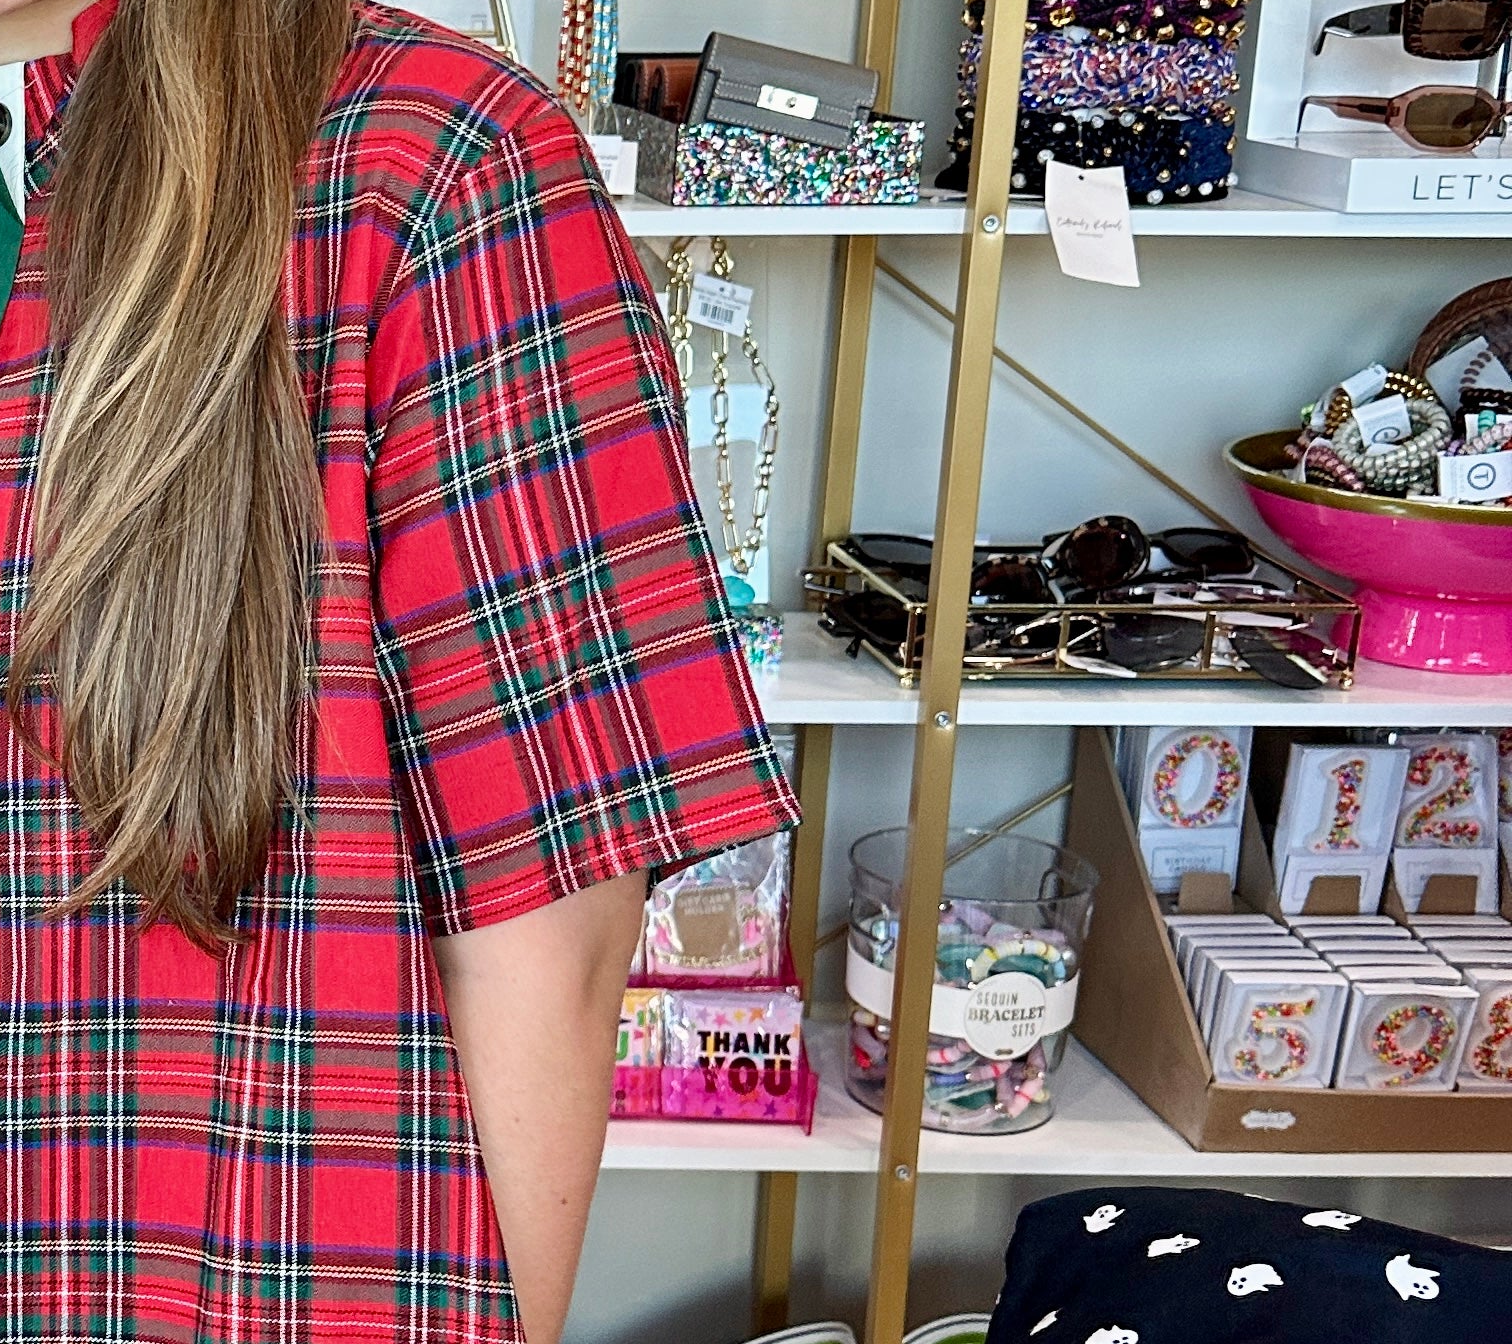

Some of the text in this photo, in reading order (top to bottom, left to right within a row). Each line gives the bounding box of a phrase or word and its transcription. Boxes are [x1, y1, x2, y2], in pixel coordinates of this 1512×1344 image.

[1412, 174, 1512, 200] LET'S
[976, 991, 1018, 1006] SEQUIN
[968, 1005, 1045, 1024] BRACELET
[1012, 1023, 1036, 1038] SETS
[697, 1029, 791, 1056] THANK
[698, 1056, 791, 1097] YOU
